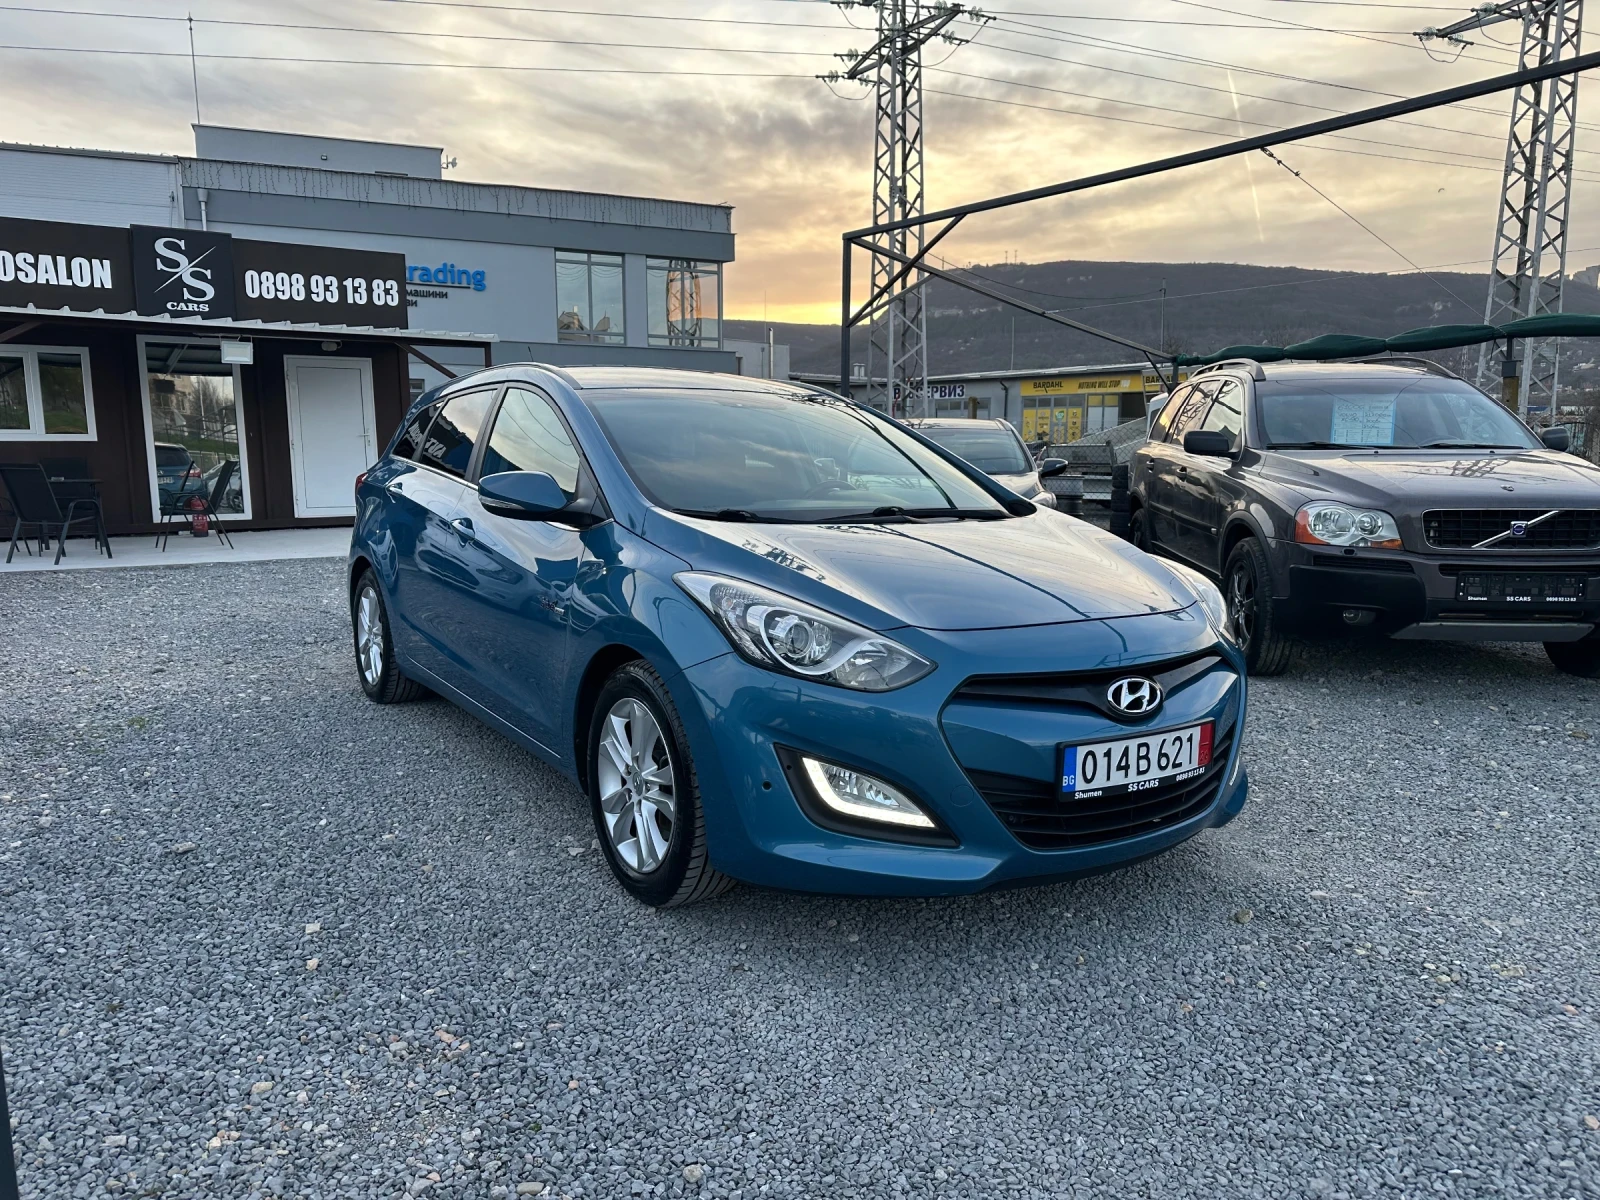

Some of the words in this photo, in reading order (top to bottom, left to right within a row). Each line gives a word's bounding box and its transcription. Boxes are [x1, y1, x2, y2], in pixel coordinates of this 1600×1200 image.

[405, 262, 486, 292] rading
[244, 269, 306, 301] 0898
[310, 274, 339, 303] 93
[343, 277, 368, 305] 13
[372, 279, 399, 307] 83
[166, 301, 210, 312] CARS
[1033, 381, 1064, 392] BARDAHL
[1109, 379, 1121, 388] STOP
[1063, 775, 1075, 787] BG
[1074, 790, 1103, 800] Shumen
[1128, 782, 1139, 792] SS
[1139, 779, 1159, 790] CARS
